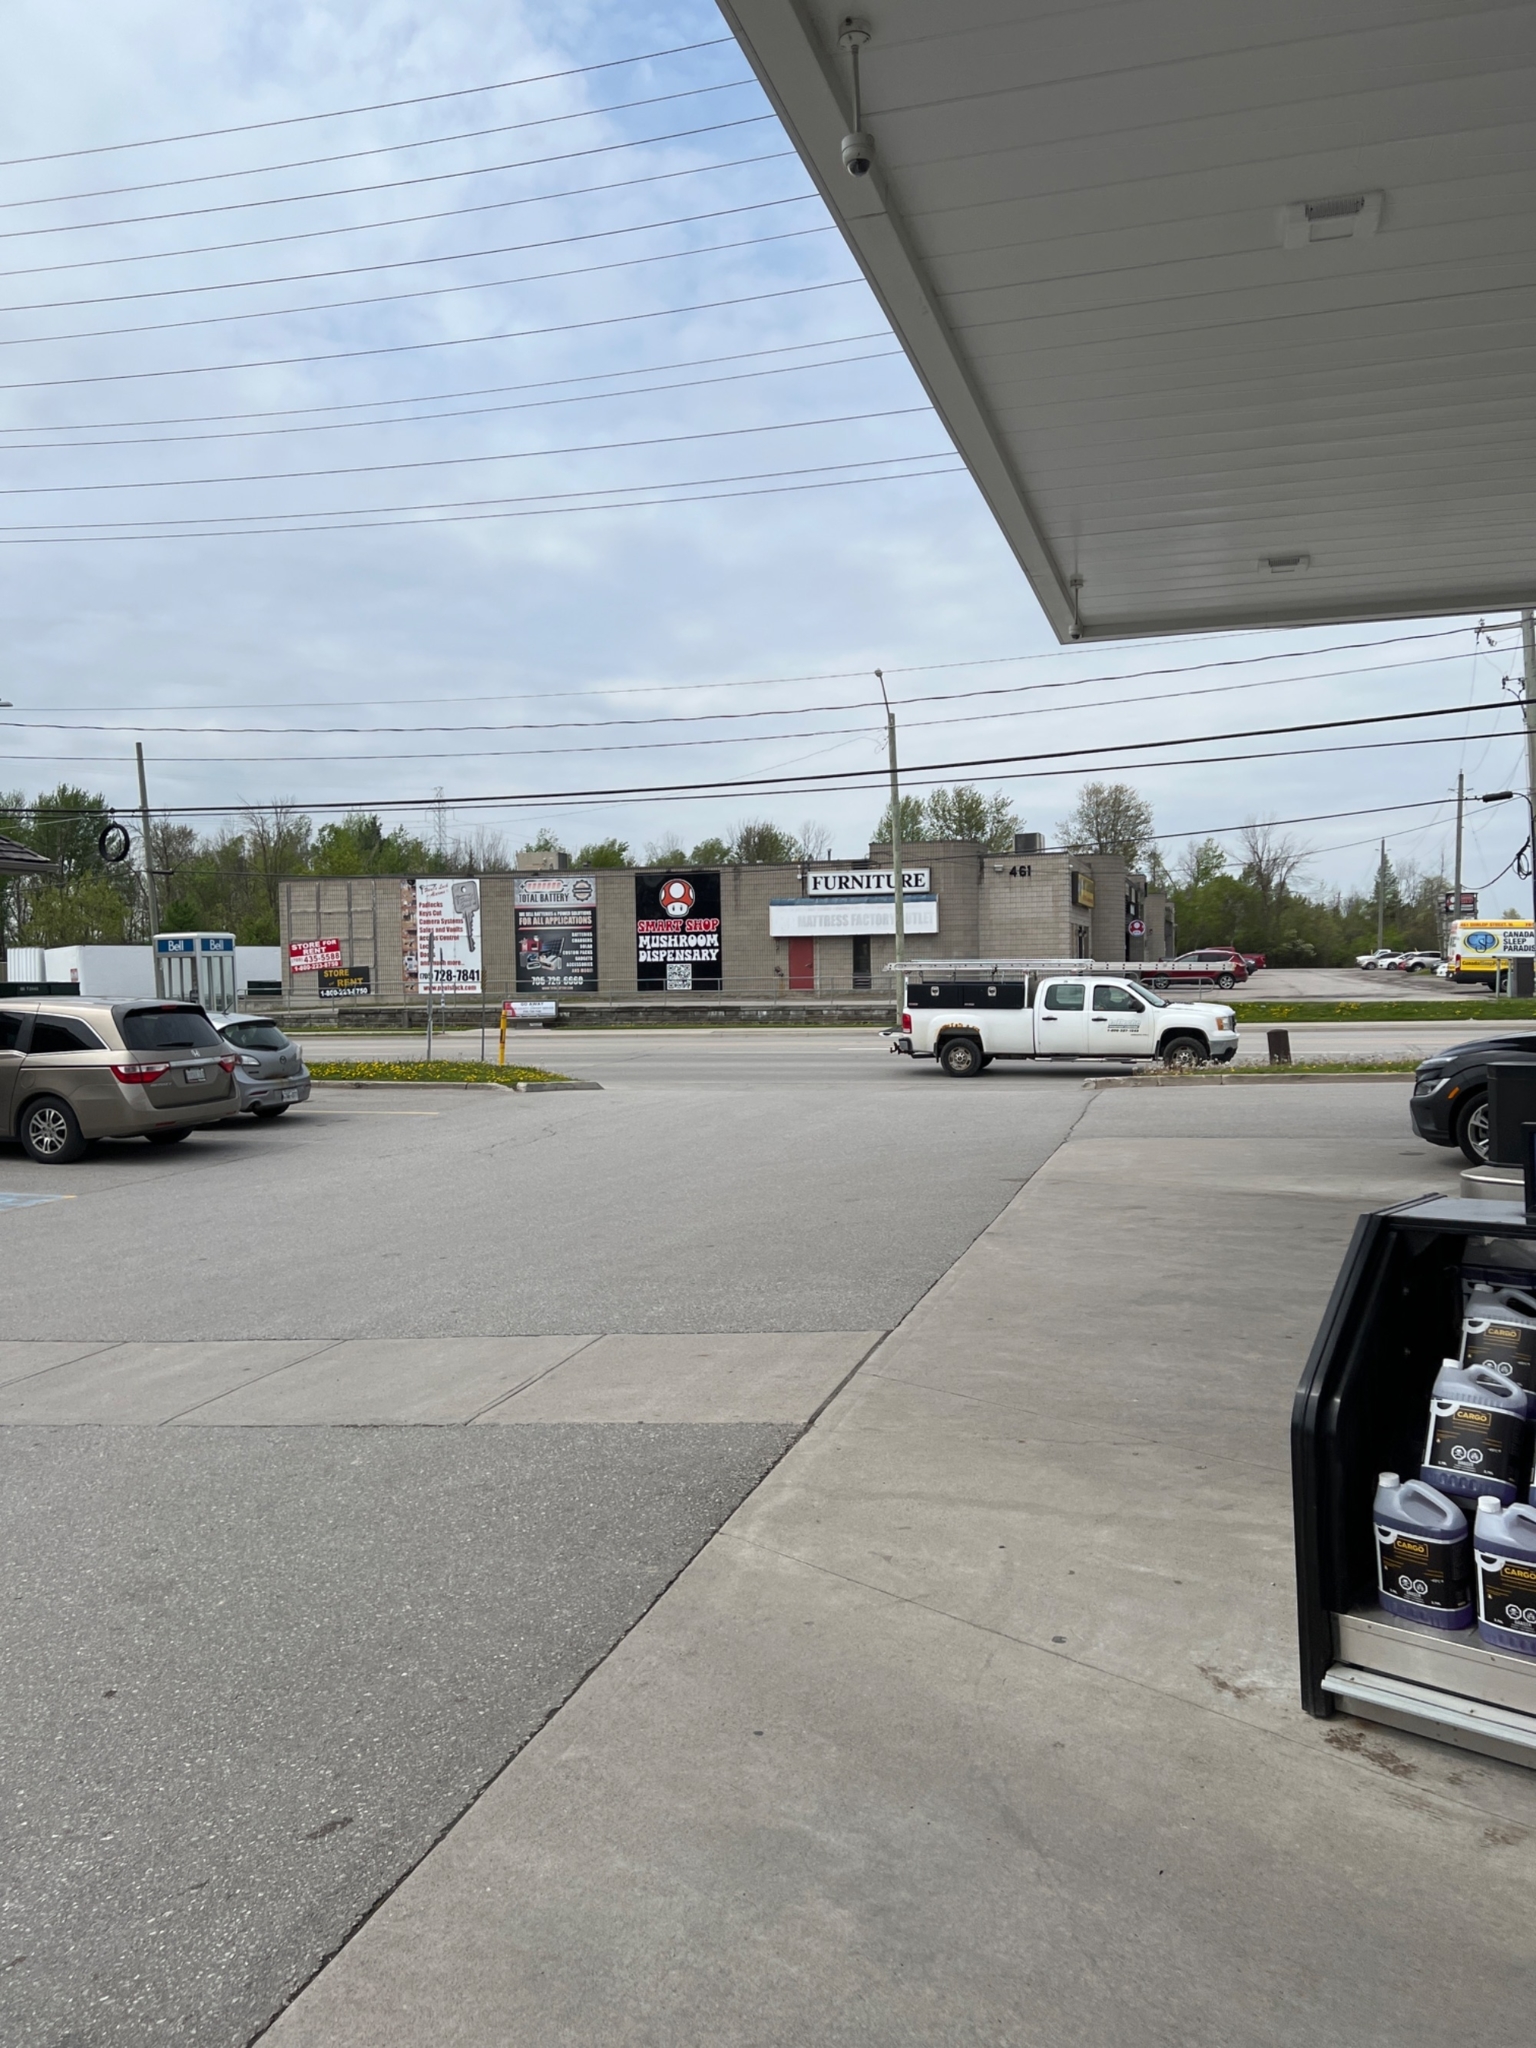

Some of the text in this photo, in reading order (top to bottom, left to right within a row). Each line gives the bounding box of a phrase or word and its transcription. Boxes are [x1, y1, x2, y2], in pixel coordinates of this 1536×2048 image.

[1009, 865, 1032, 878] 461
[812, 873, 926, 891] FURNITURE
[518, 893, 569, 903] TOTAL BATTERY
[519, 916, 592, 925] FOR ALL APPLICATIONS
[638, 918, 719, 933] SMART SHOP
[797, 912, 933, 927] MATTRESS FACTORY UTLET
[168, 940, 184, 952] Bell
[209, 939, 224, 951] Bell
[291, 942, 320, 951] STORE
[639, 934, 719, 949] MUSHROOM
[303, 947, 326, 955] RENT
[639, 949, 719, 962] DISPENSARY
[304, 953, 340, 963] 435-5588
[323, 969, 350, 978] STORE
[434, 969, 480, 981] 728-7841
[336, 978, 363, 987] RENT
[1488, 1328, 1518, 1338] CARGO
[1456, 1411, 1488, 1422] CARGO
[1396, 1540, 1425, 1553] CARGO
[1504, 1567, 1536, 1580] CARGO
